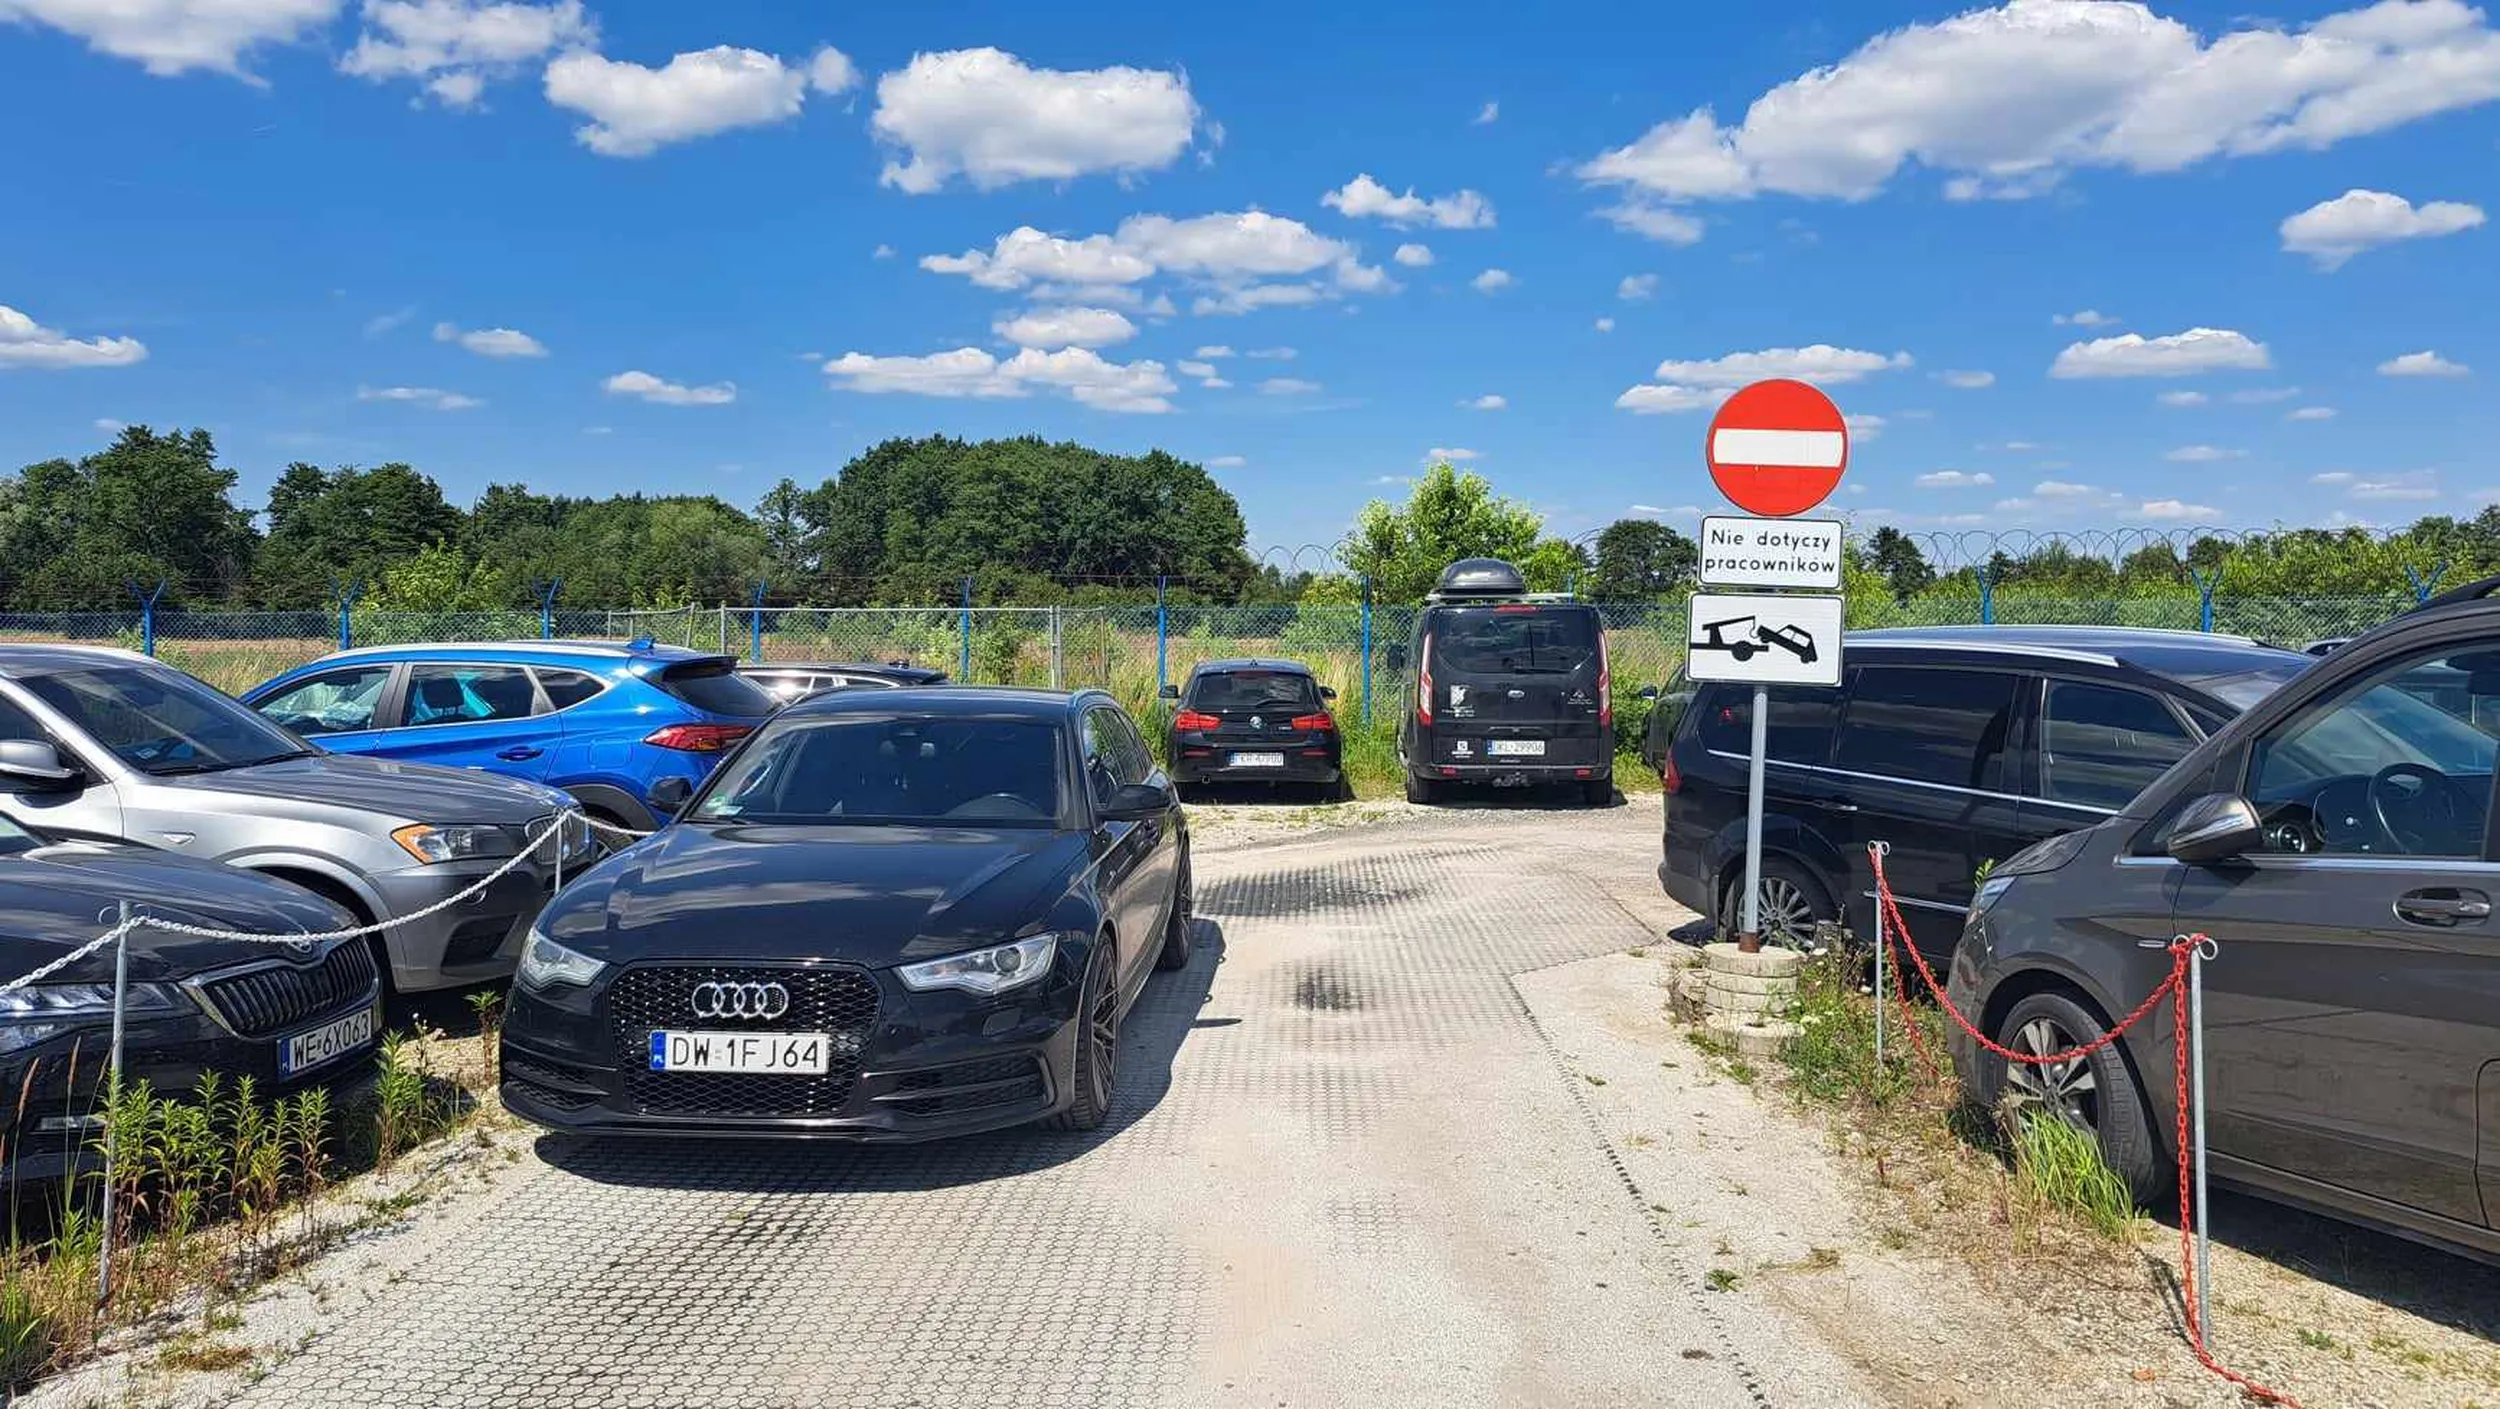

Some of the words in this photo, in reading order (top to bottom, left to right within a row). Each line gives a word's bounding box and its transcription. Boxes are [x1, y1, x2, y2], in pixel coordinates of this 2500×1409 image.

[1711, 529, 1744, 545] Nie
[1757, 531, 1831, 552] dotyczy
[1705, 557, 1835, 573] pracowników
[294, 1033, 317, 1068] WE
[322, 1013, 369, 1056] 6X063
[672, 1037, 711, 1066] DW
[726, 1038, 818, 1068] 1FJ64
